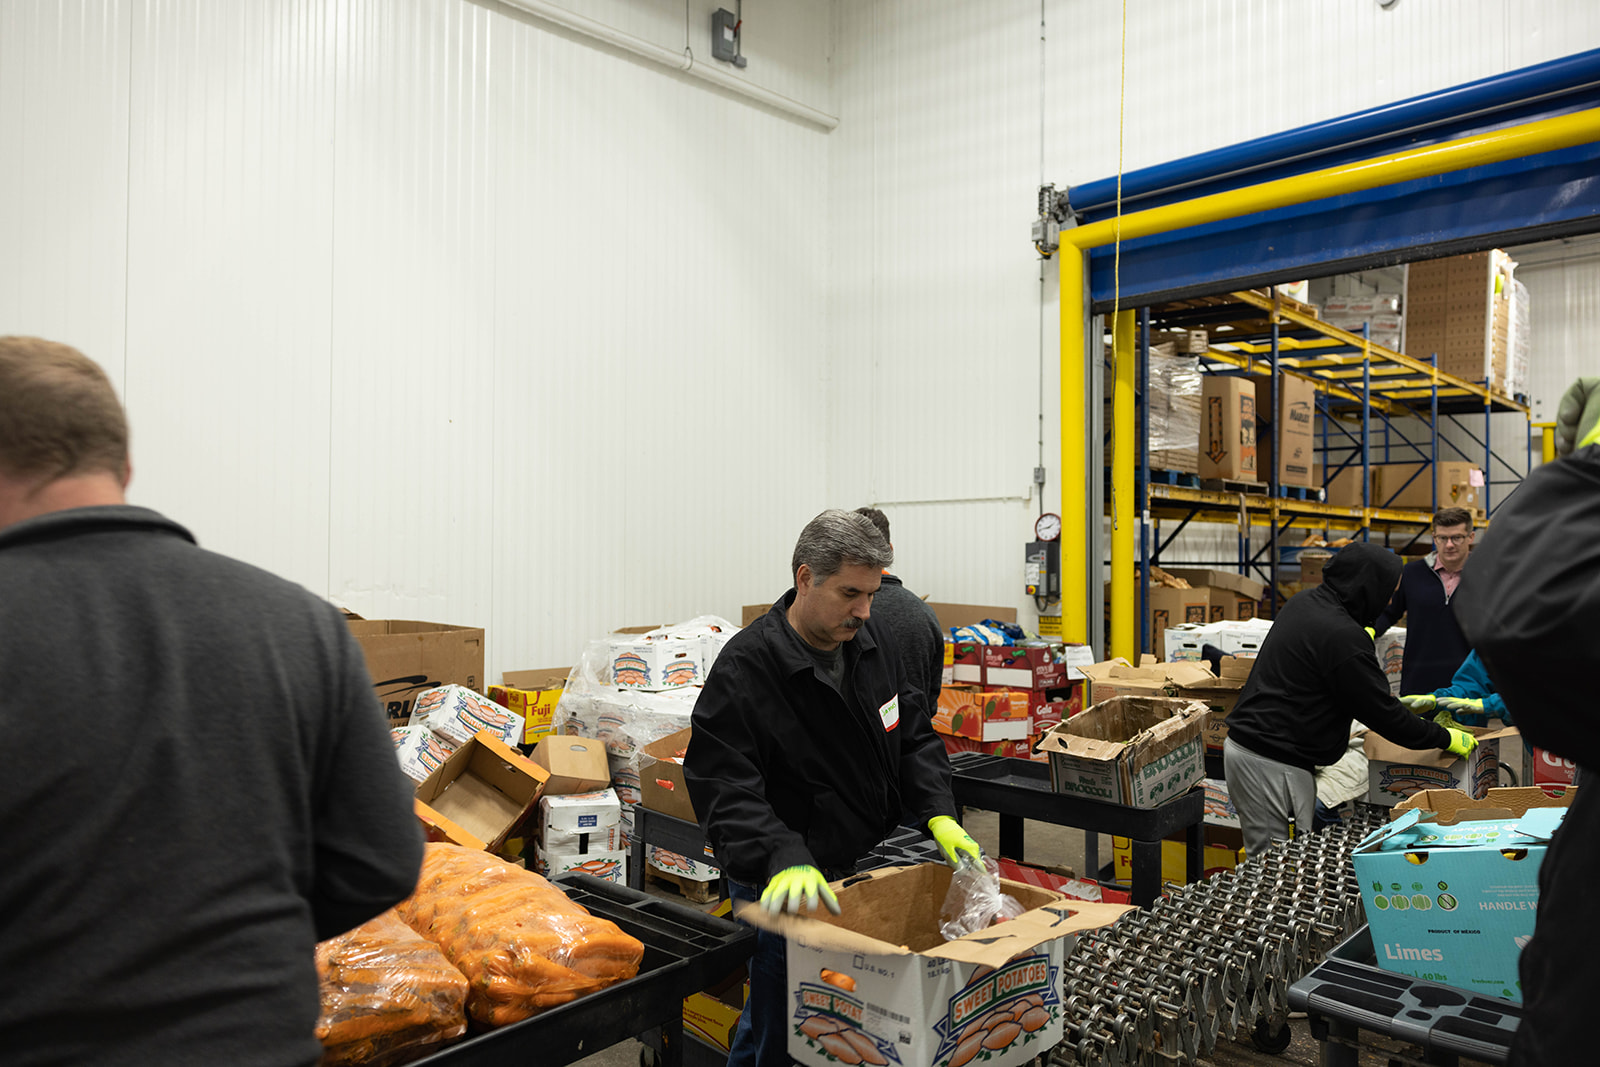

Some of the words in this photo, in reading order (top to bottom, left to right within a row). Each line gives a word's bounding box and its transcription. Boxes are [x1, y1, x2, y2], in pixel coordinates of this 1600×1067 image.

[531, 704, 551, 718] Fuji
[1036, 704, 1053, 715] Gala
[1390, 768, 1412, 776] SWEET
[1414, 768, 1449, 782] POTATOES
[1064, 780, 1113, 799] BROCCOLI
[1204, 789, 1229, 803] OTATOES
[1478, 901, 1527, 911] HANDLE
[1527, 901, 1538, 911] W
[1384, 943, 1444, 962] Limes
[1434, 972, 1448, 981] lbs
[955, 981, 994, 1021] SWEET
[997, 962, 1047, 996] POTATOES
[803, 990, 832, 1010] SWEET
[834, 997, 863, 1021] POTAT
